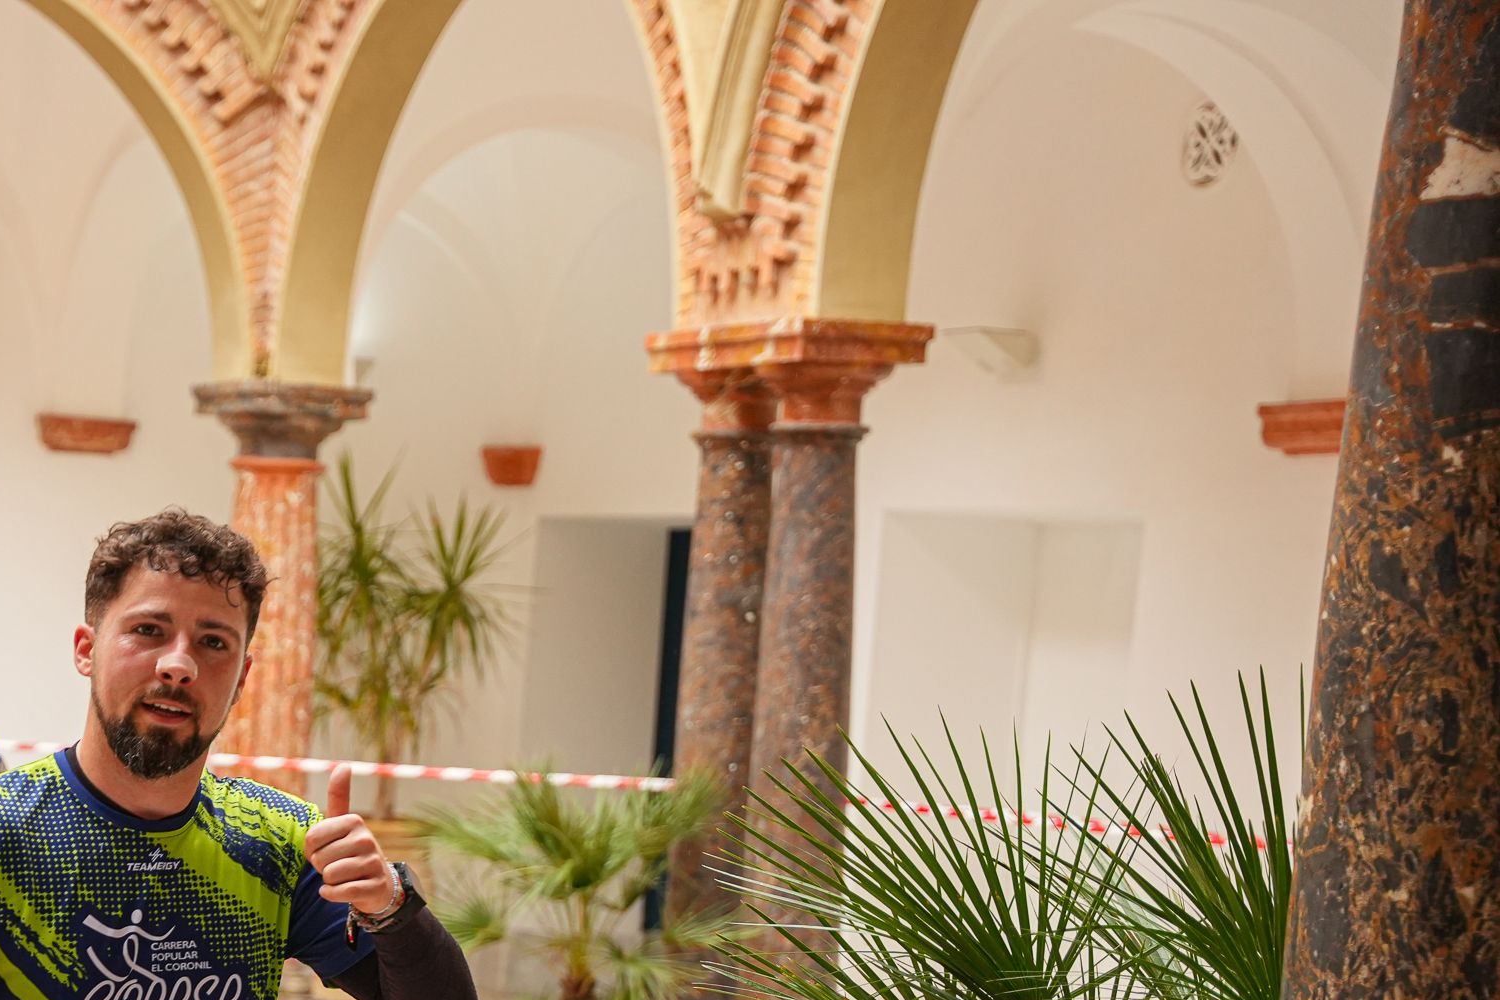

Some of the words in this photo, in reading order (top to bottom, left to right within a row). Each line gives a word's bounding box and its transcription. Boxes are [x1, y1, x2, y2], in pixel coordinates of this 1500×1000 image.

[150, 940, 197, 950] CARRERA
[151, 951, 199, 961] POPULAR
[151, 963, 163, 972] EL
[164, 961, 212, 971] CORONIL
